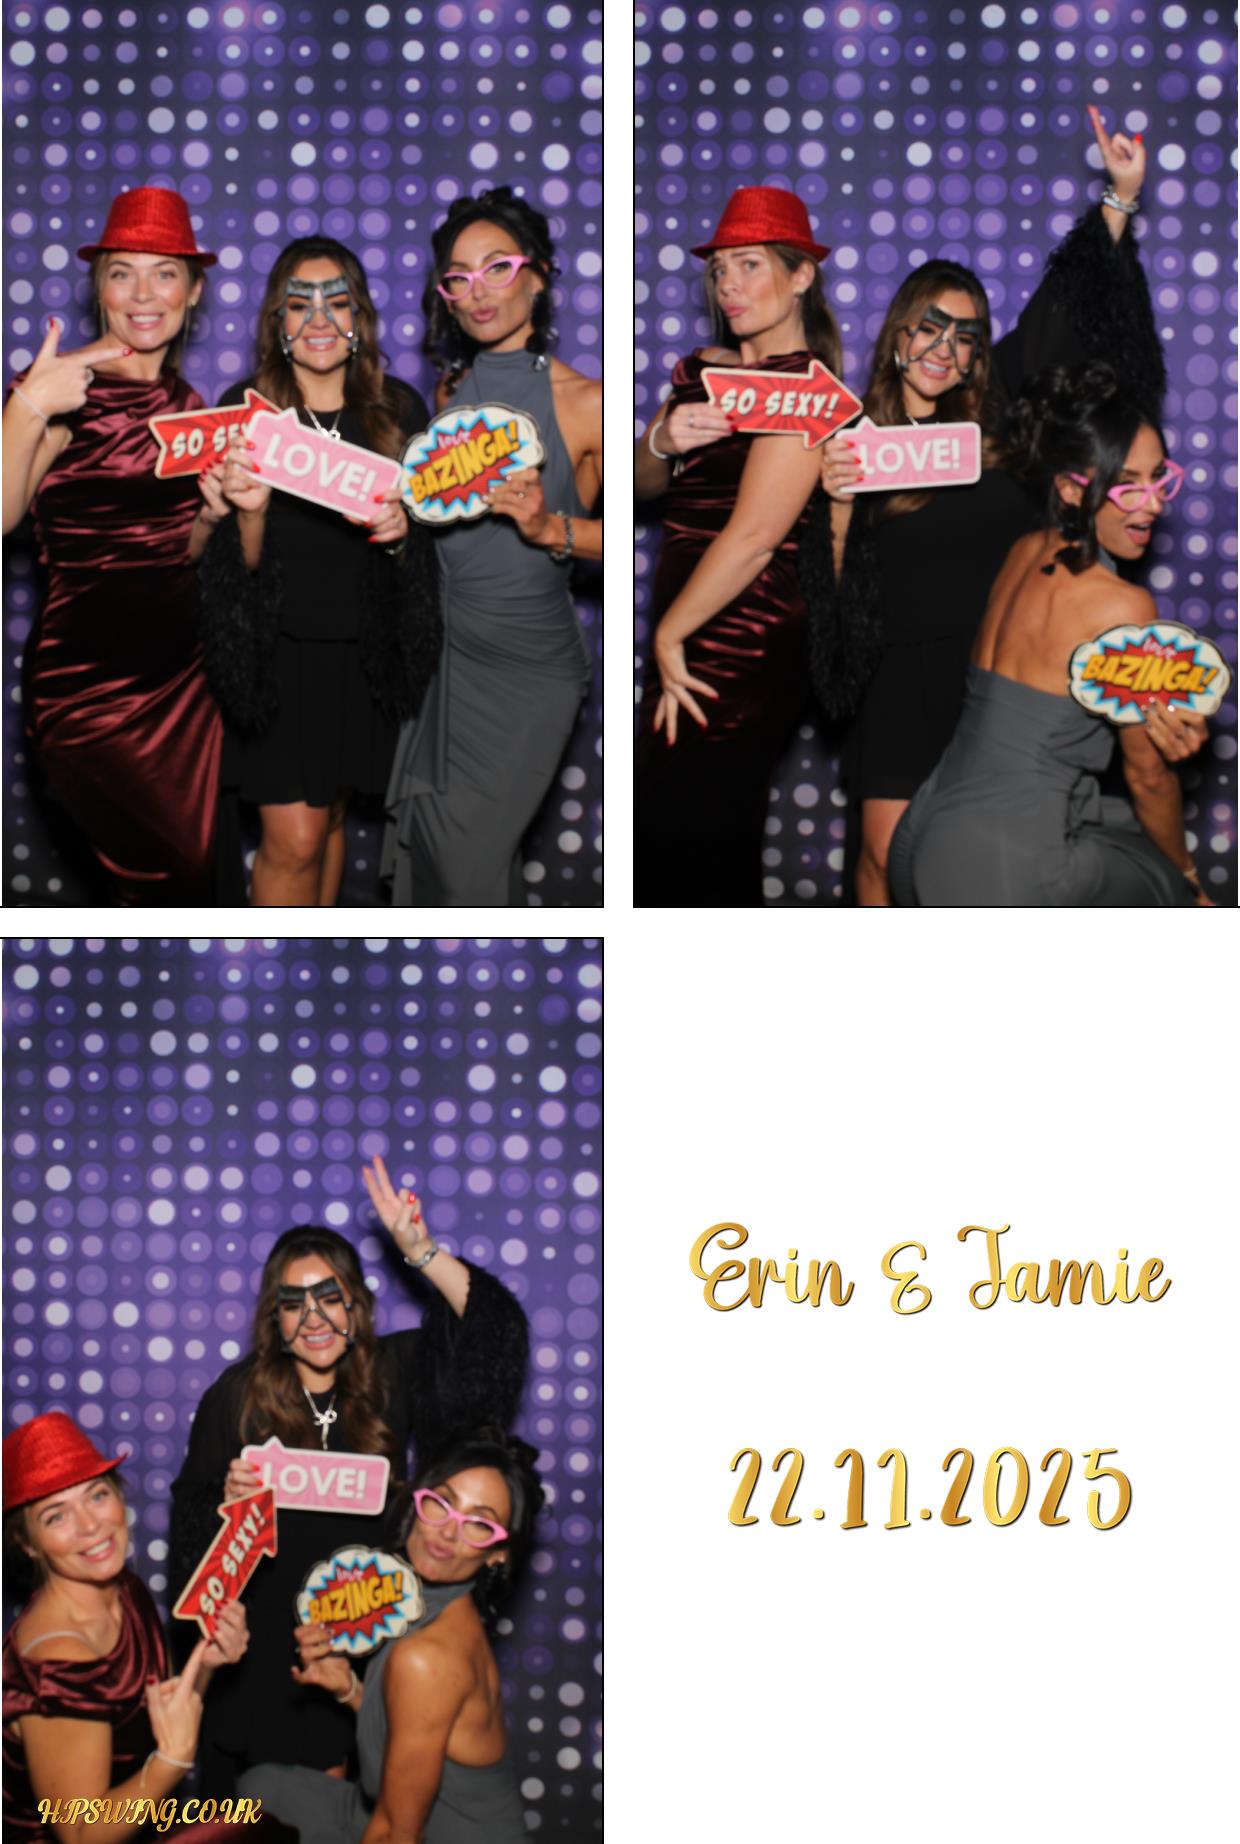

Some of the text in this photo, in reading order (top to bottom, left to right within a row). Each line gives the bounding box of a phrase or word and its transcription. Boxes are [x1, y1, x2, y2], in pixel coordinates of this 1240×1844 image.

[720, 387, 840, 419] SO SEXY!
[171, 430, 204, 460] SO
[409, 419, 520, 504] BAZINGA!
[858, 437, 961, 477] LOVE!
[260, 432, 377, 502] LOVE!
[1081, 654, 1218, 694] BAZINGA!
[262, 1462, 367, 1500] LOVE!
[200, 1502, 267, 1617] SO SEXY!
[308, 1569, 404, 1624] BAZINGA!
